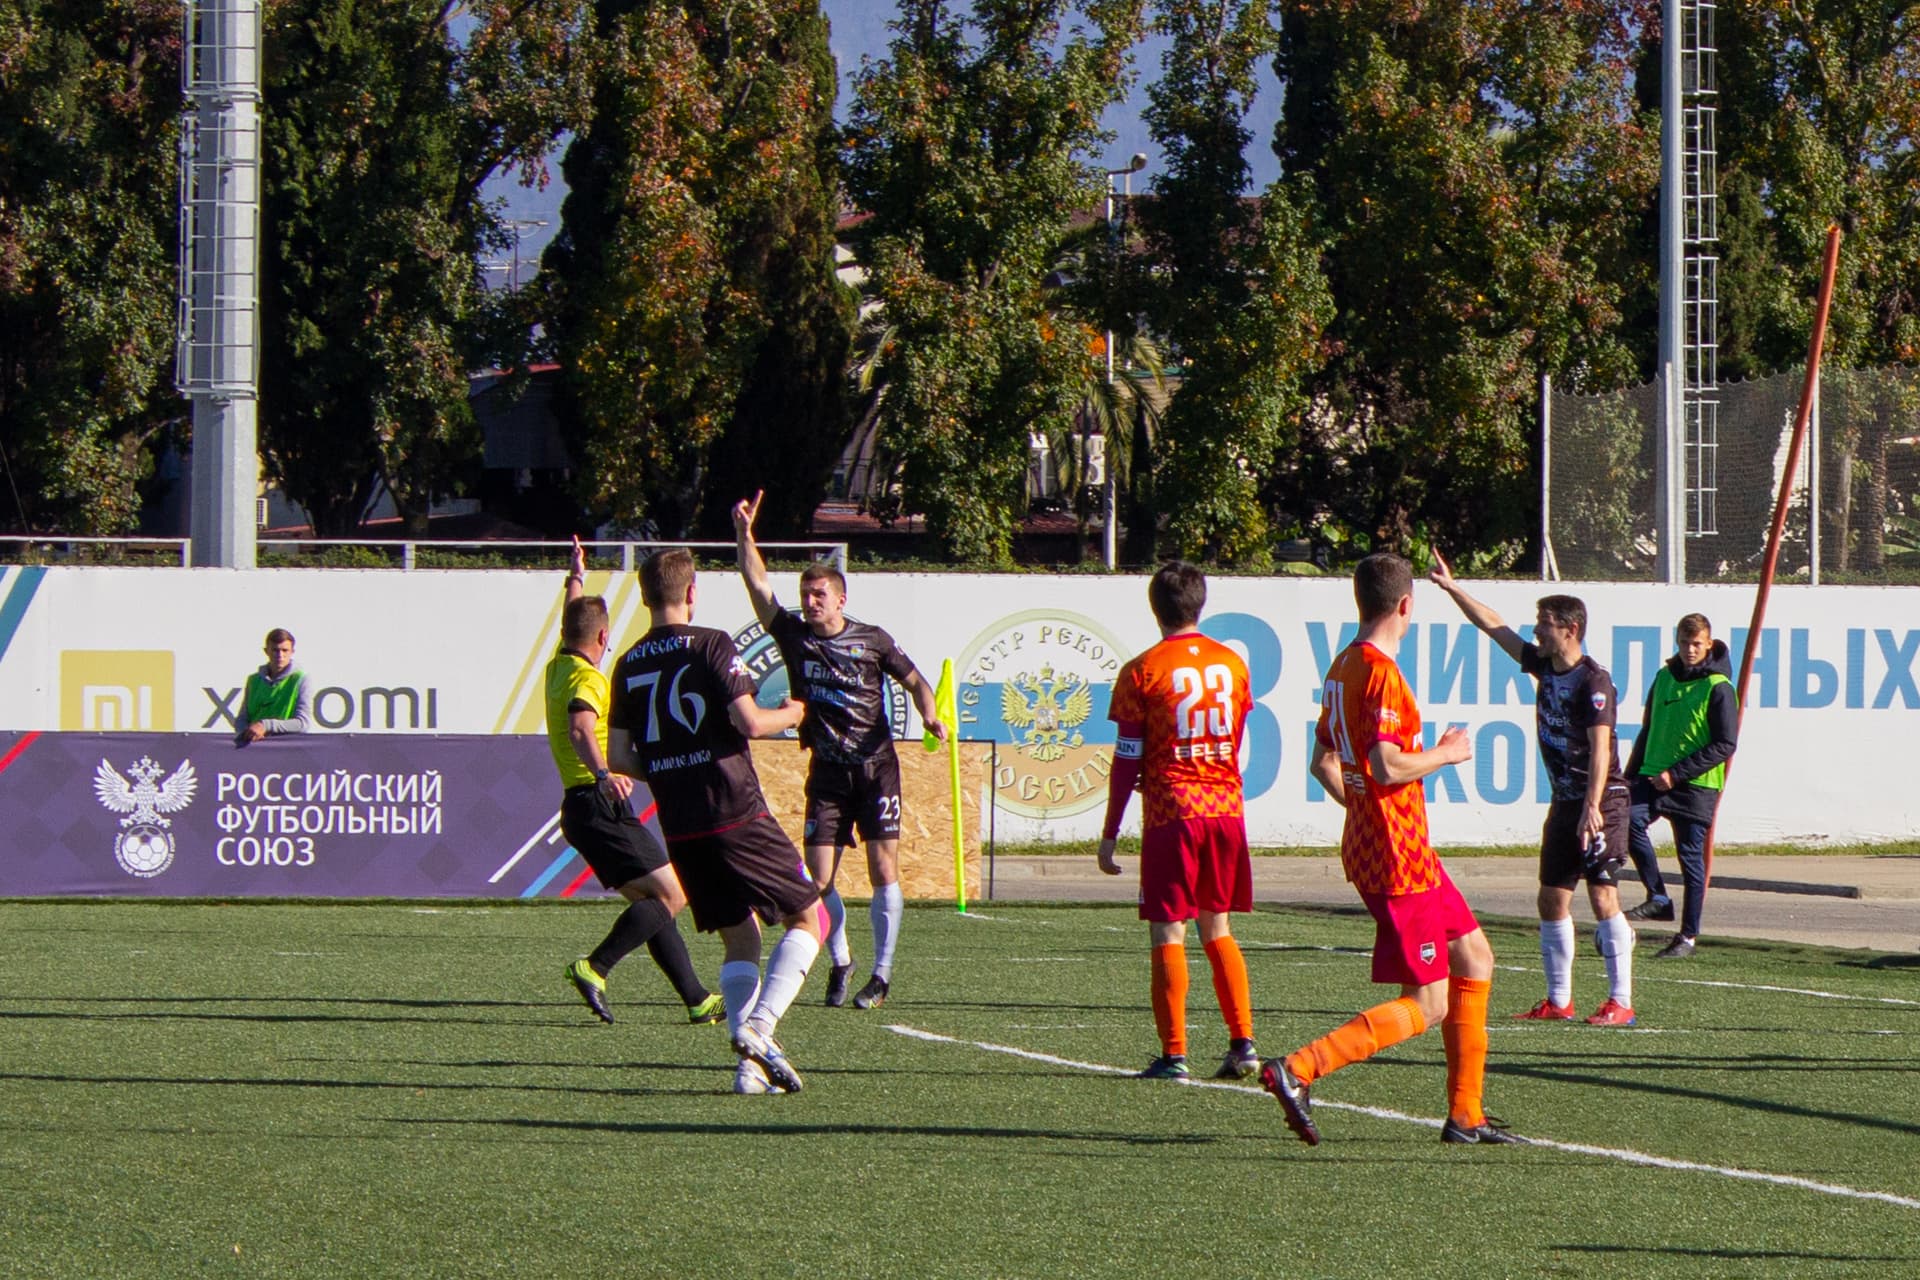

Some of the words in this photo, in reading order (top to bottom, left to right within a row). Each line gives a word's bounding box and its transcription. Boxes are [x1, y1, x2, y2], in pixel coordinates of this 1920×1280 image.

[960, 631, 1025, 724] РЕЕСТР
[1037, 625, 1118, 690] РЕКОР
[1305, 621, 1920, 709] УИКЛНЫХ
[202, 687, 437, 729] xomi
[626, 664, 706, 742] 76
[1173, 664, 1233, 739] 23
[217, 770, 442, 802] РОССИЙСКИЙ
[216, 804, 442, 835] ФУТБОЛЬНЫЙ
[878, 795, 900, 820] 23
[216, 837, 315, 866] СОЮЗ
